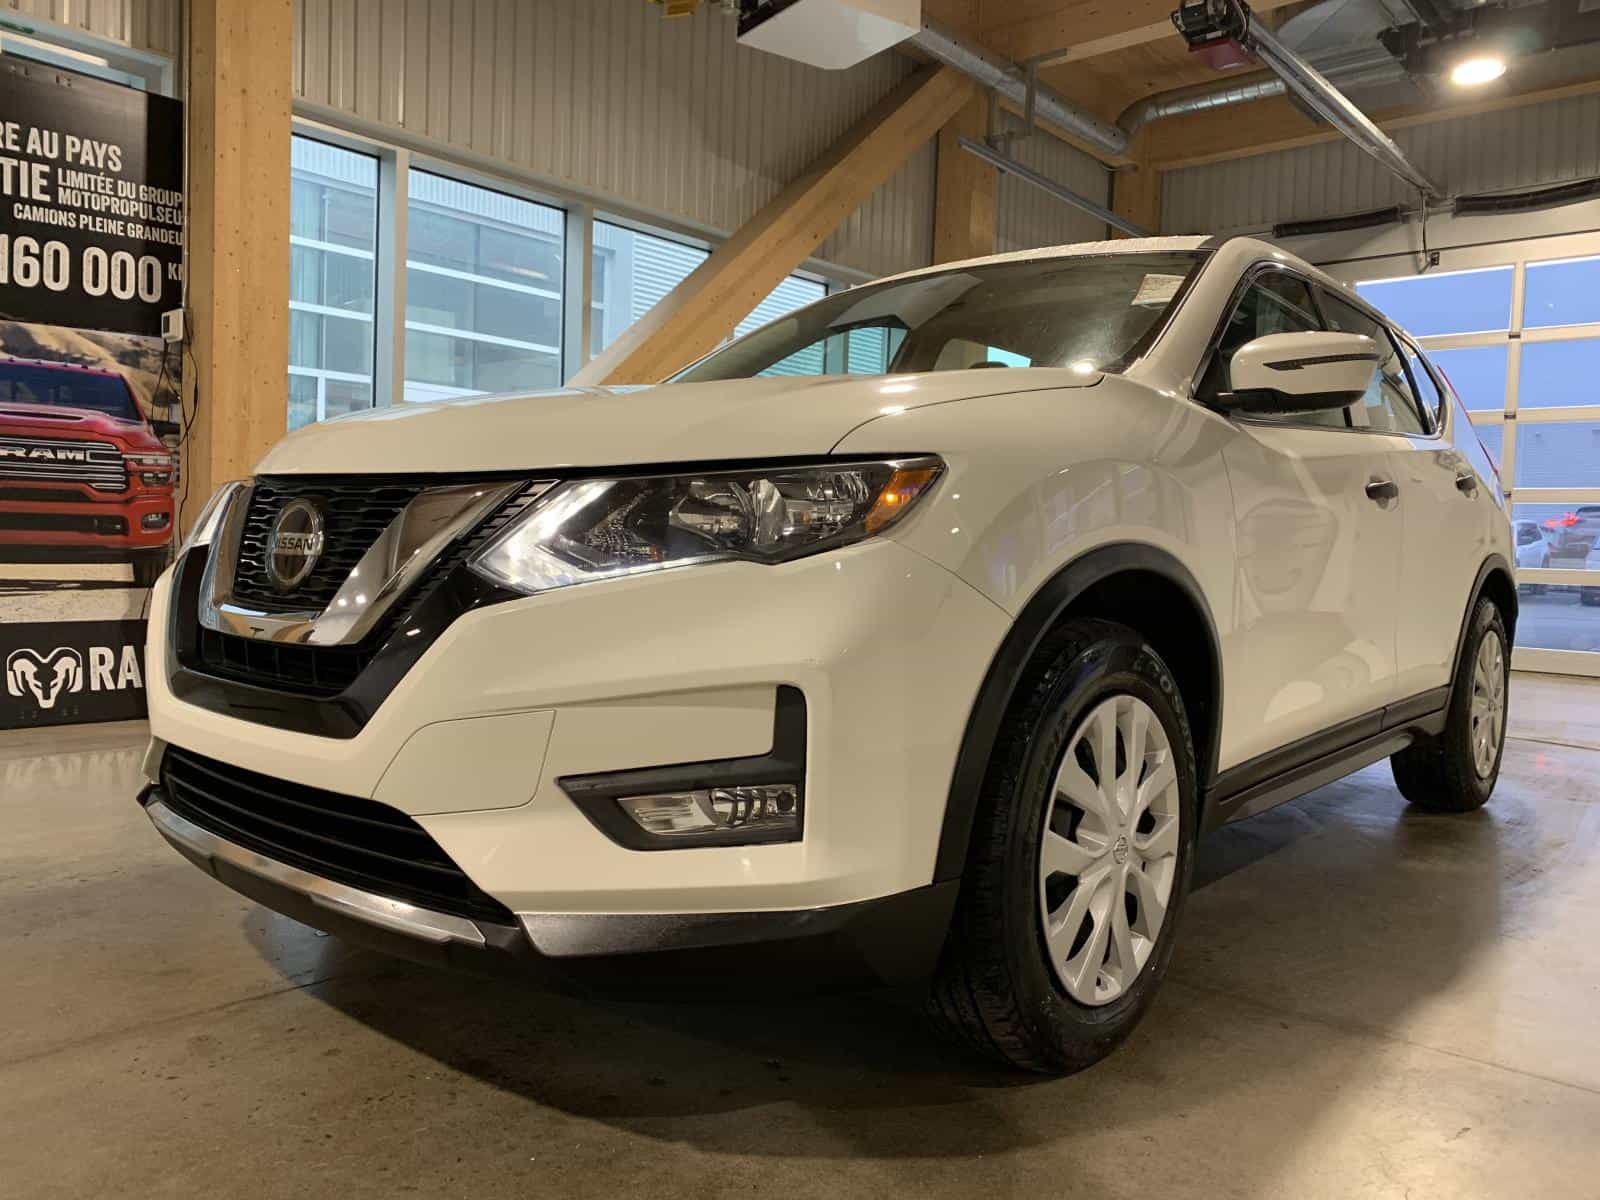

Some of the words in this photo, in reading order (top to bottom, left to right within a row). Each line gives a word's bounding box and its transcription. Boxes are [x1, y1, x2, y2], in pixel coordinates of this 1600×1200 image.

[26, 127, 59, 159] AU
[65, 134, 122, 172] PAYS
[0, 156, 51, 202] TIE
[58, 167, 114, 195] LIMITÉE
[118, 179, 136, 198] DU
[13, 202, 77, 228] CAMIONS
[79, 213, 125, 236] PLEINE
[0, 233, 70, 292] 160
[82, 246, 162, 304] 000
[0, 446, 85, 460] RAM
[88, 645, 147, 691] RA
